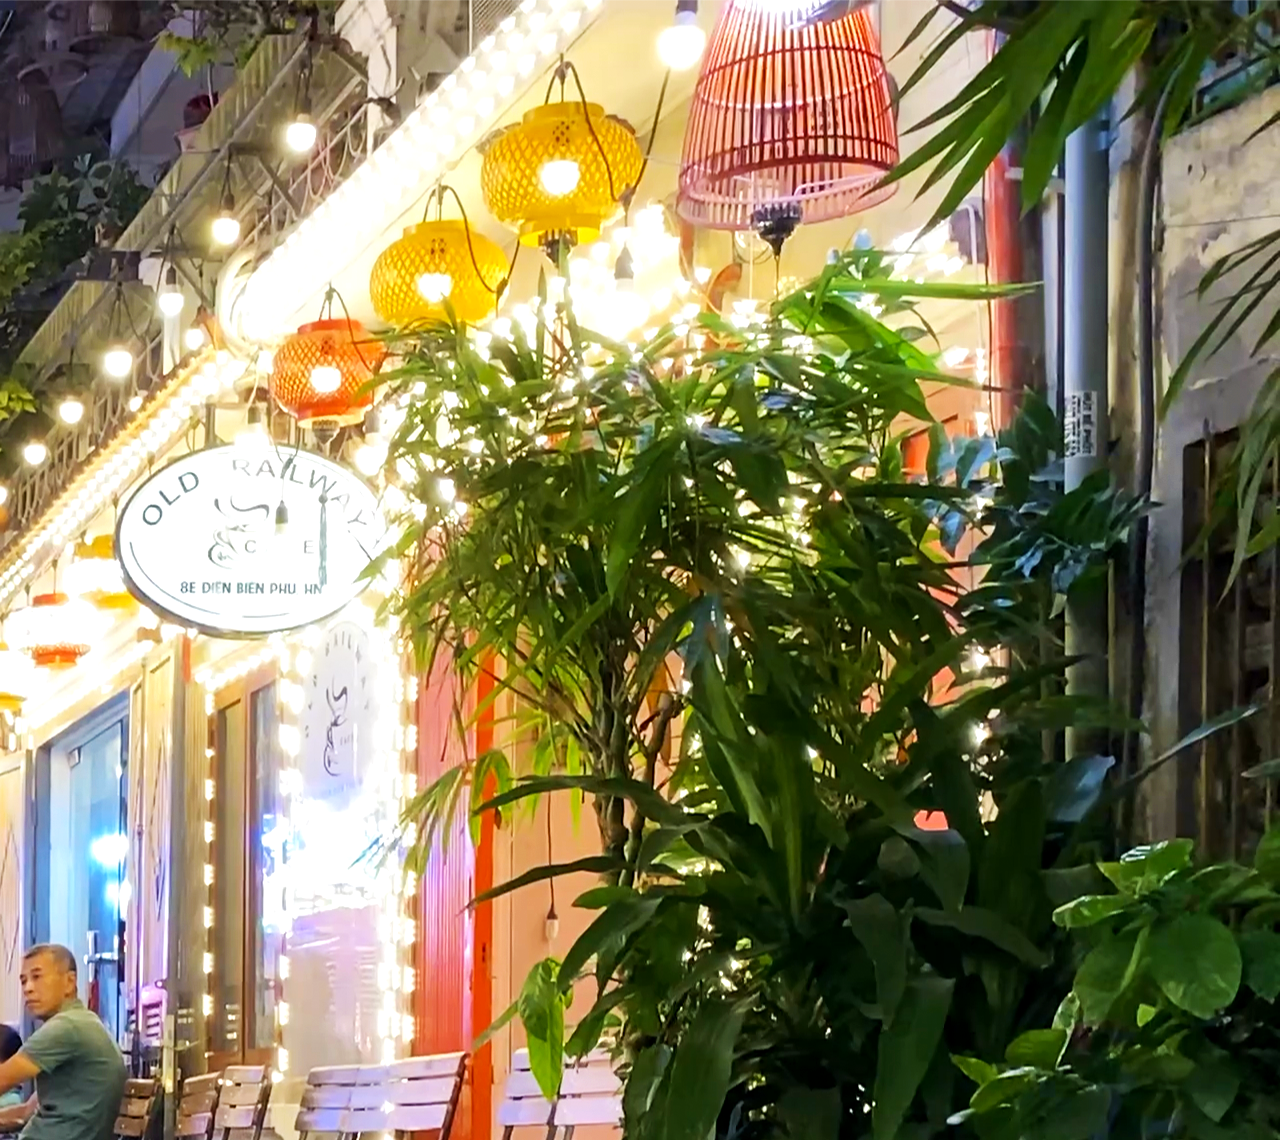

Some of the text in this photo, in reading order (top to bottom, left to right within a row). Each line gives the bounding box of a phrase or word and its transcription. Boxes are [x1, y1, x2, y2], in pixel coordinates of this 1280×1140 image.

[142, 458, 368, 526] OLD RAILWAY
[244, 539, 315, 555] CE
[180, 581, 196, 594] 8E
